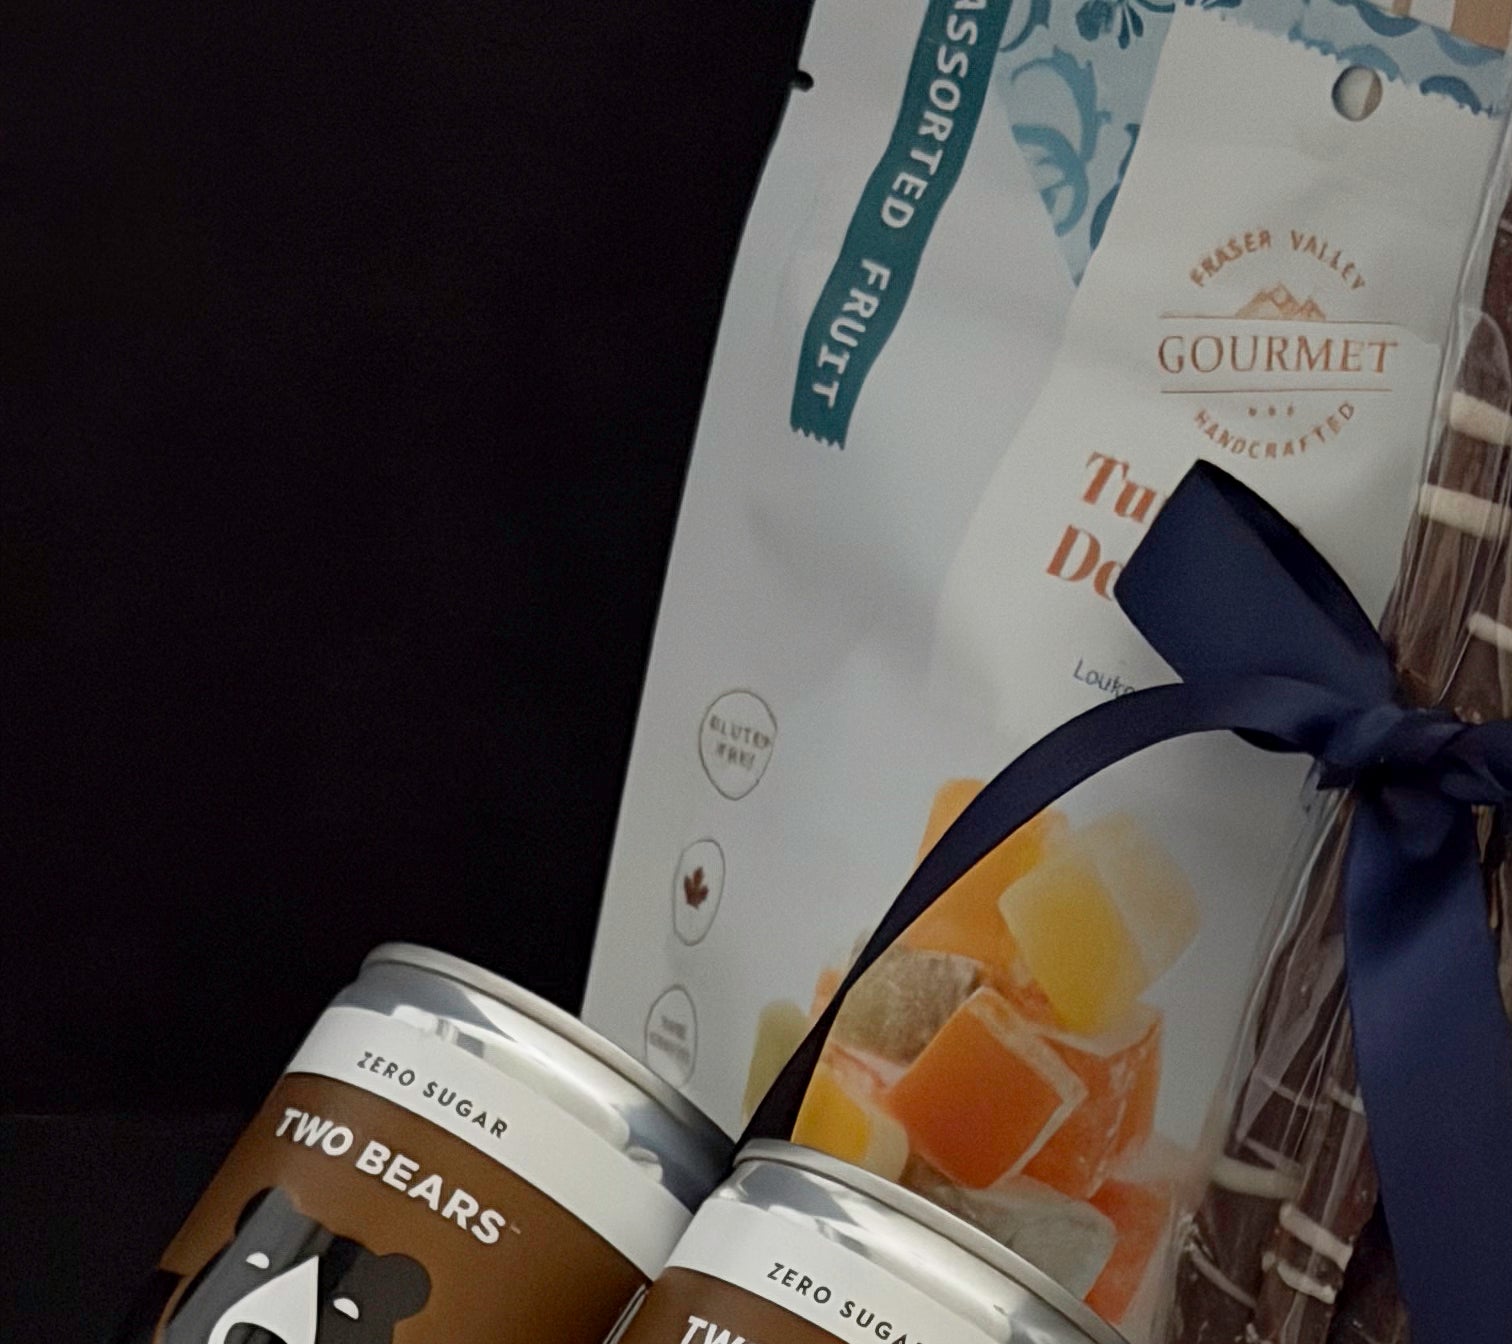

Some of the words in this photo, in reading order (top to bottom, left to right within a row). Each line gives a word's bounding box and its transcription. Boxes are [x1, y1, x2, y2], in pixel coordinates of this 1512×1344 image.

[1189, 229, 1272, 288] FRASER
[1290, 229, 1366, 290] VALLEY
[816, 258, 890, 406] FRUIT
[1158, 334, 1400, 374] GOURMET
[1194, 400, 1355, 459] HANDCRAFTED
[1083, 451, 1165, 524] Tu
[356, 1051, 417, 1088] ZERO
[423, 1080, 509, 1139] SUGAR
[274, 1107, 354, 1156] TWO
[355, 1139, 508, 1245] BEARS
[766, 1262, 833, 1305] ZERO
